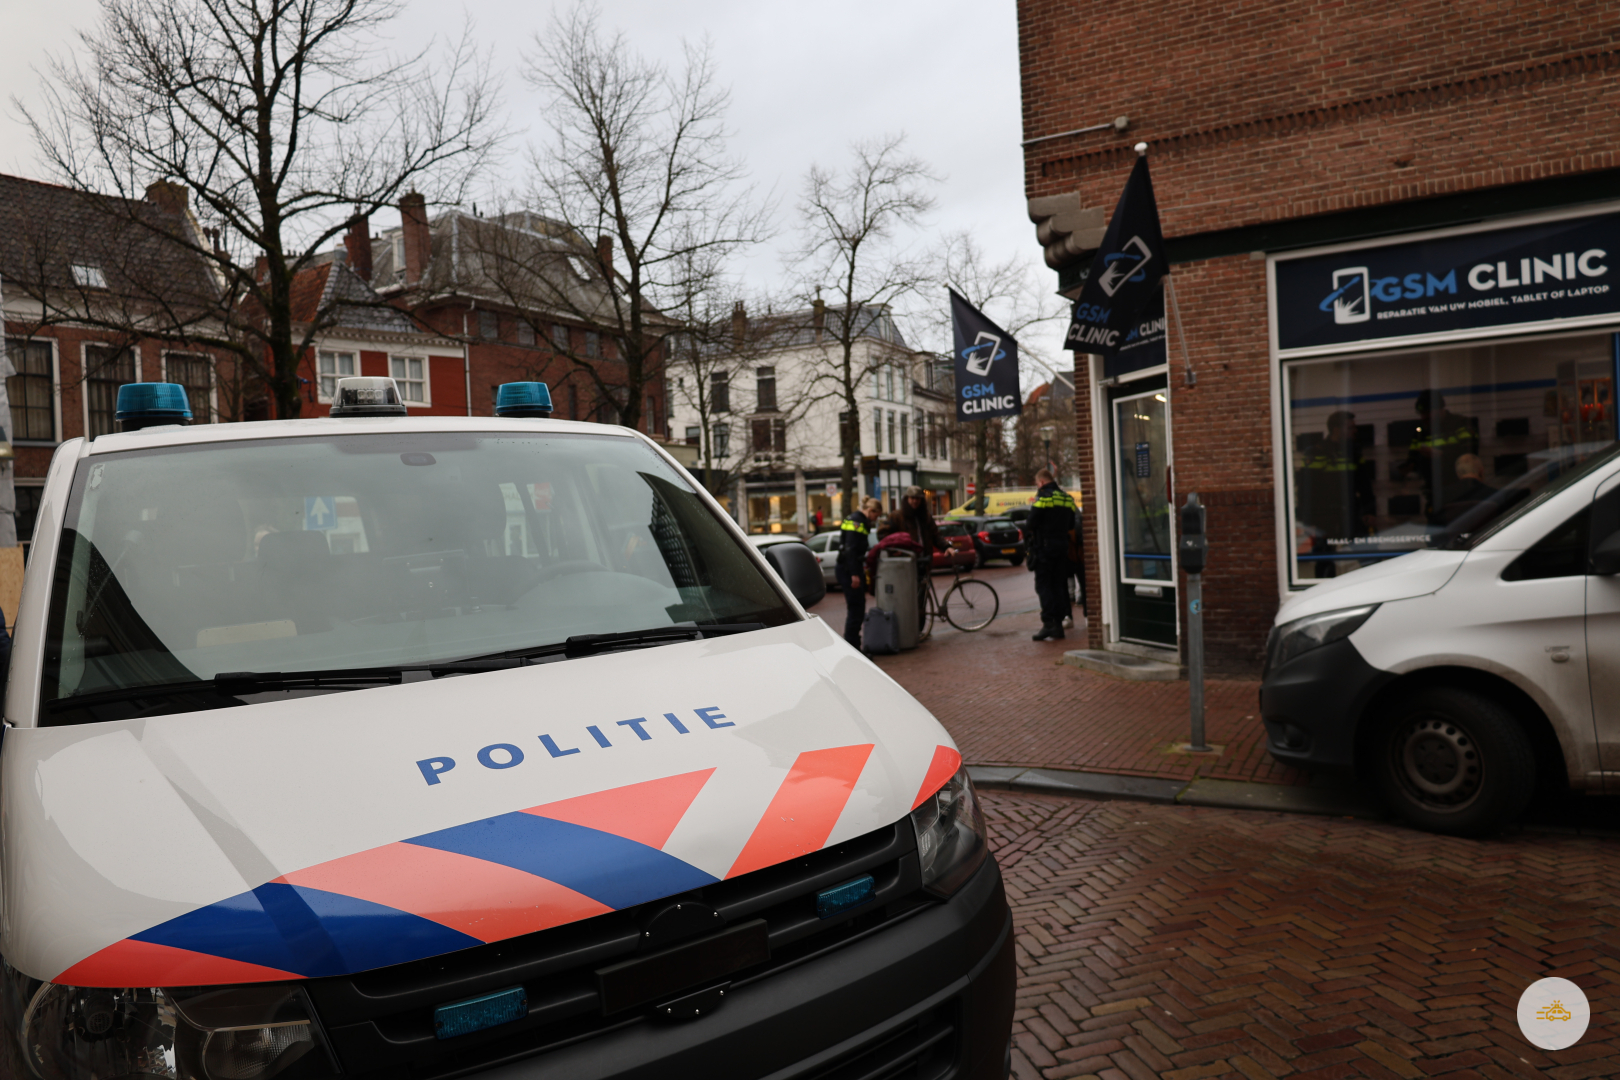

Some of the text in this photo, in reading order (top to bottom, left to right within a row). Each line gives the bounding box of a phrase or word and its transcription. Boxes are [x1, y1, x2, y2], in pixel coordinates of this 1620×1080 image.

[1376, 249, 1608, 302] GSM CLINIC
[1076, 302, 1112, 324] GSM
[1377, 306, 1427, 320] REPARATIE
[1428, 304, 1448, 313] VAN
[1449, 302, 1466, 311] UW
[1511, 292, 1548, 304] TABLET
[1550, 290, 1565, 299] OF
[1567, 285, 1610, 297] LAPTOP
[1068, 323, 1120, 347] CLINIC
[961, 382, 995, 398] GSM
[962, 395, 1015, 415] CLINIC
[1326, 534, 1431, 545] HAAL- EN BRENGSERVICE
[415, 706, 737, 786] POLITIE
